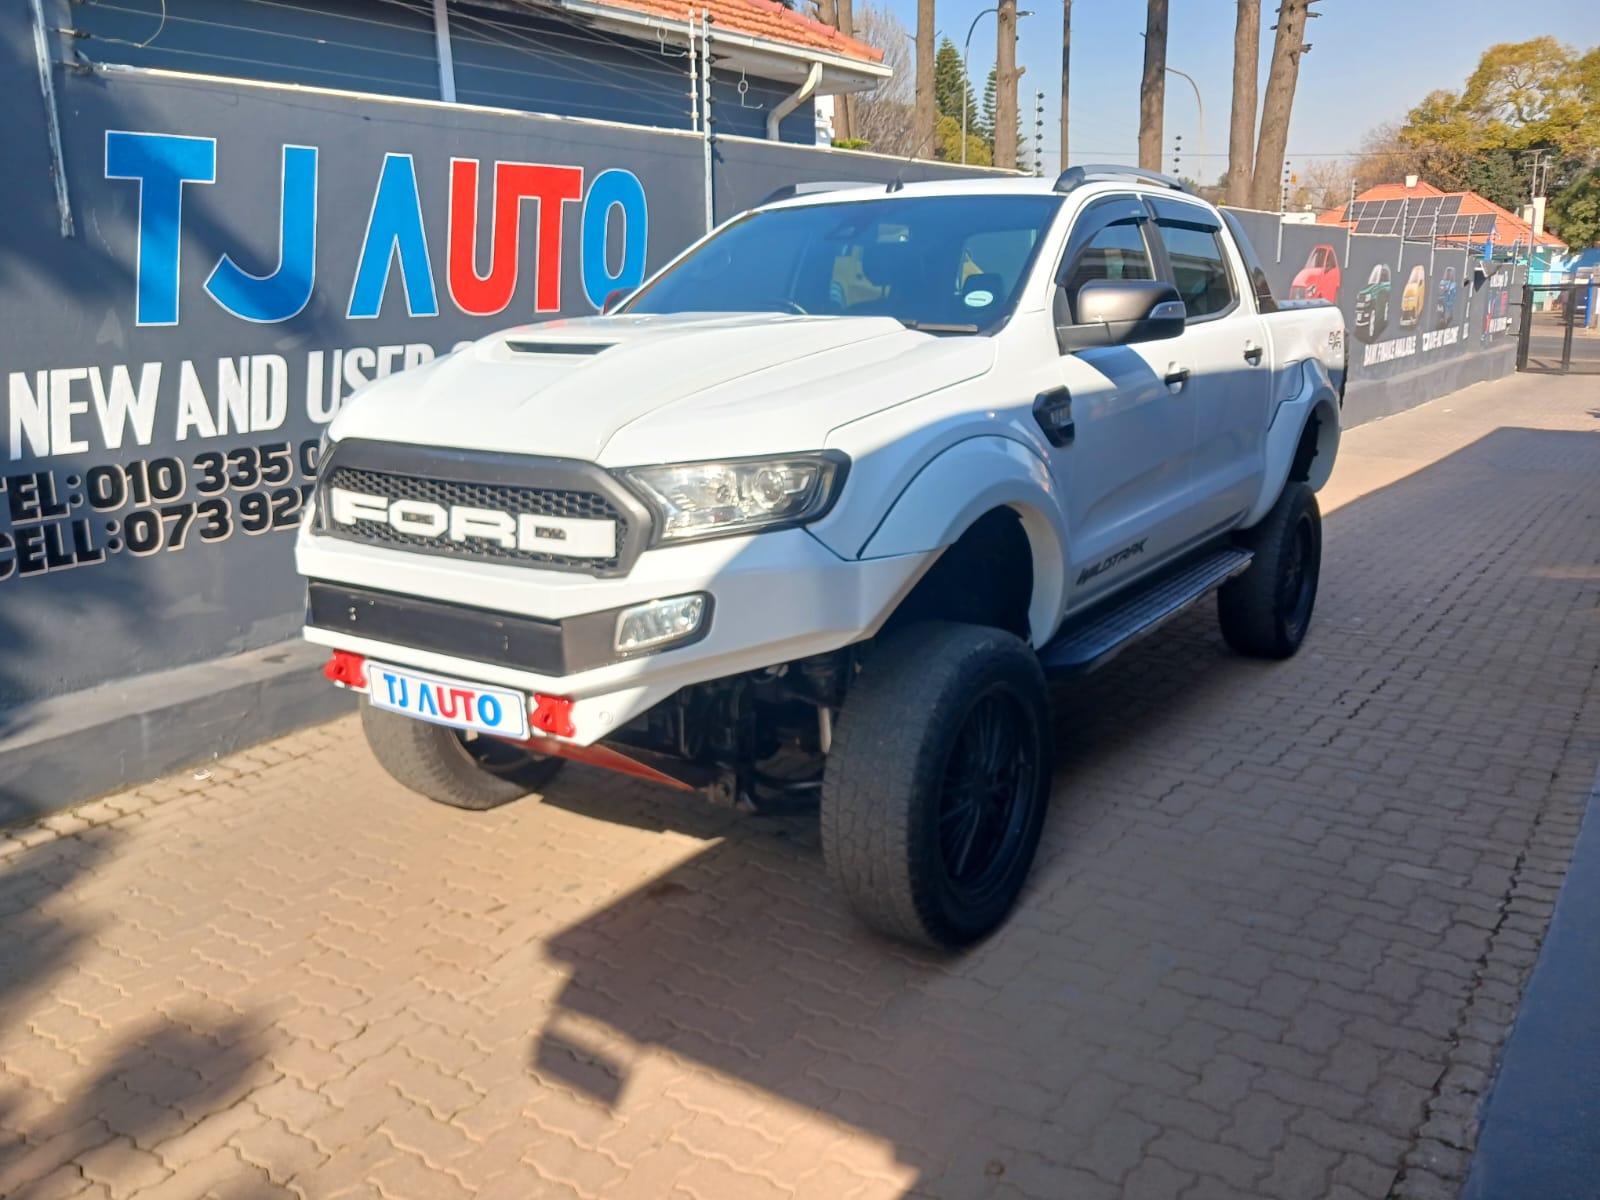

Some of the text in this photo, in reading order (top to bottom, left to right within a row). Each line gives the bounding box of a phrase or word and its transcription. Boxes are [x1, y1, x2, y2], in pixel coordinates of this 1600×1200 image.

[104, 130, 648, 326] TJ AUTO
[9, 344, 435, 460] NEW AND US
[193, 441, 293, 496] 335
[331, 487, 616, 558] FORD
[383, 673, 502, 727] TJ AUTO
